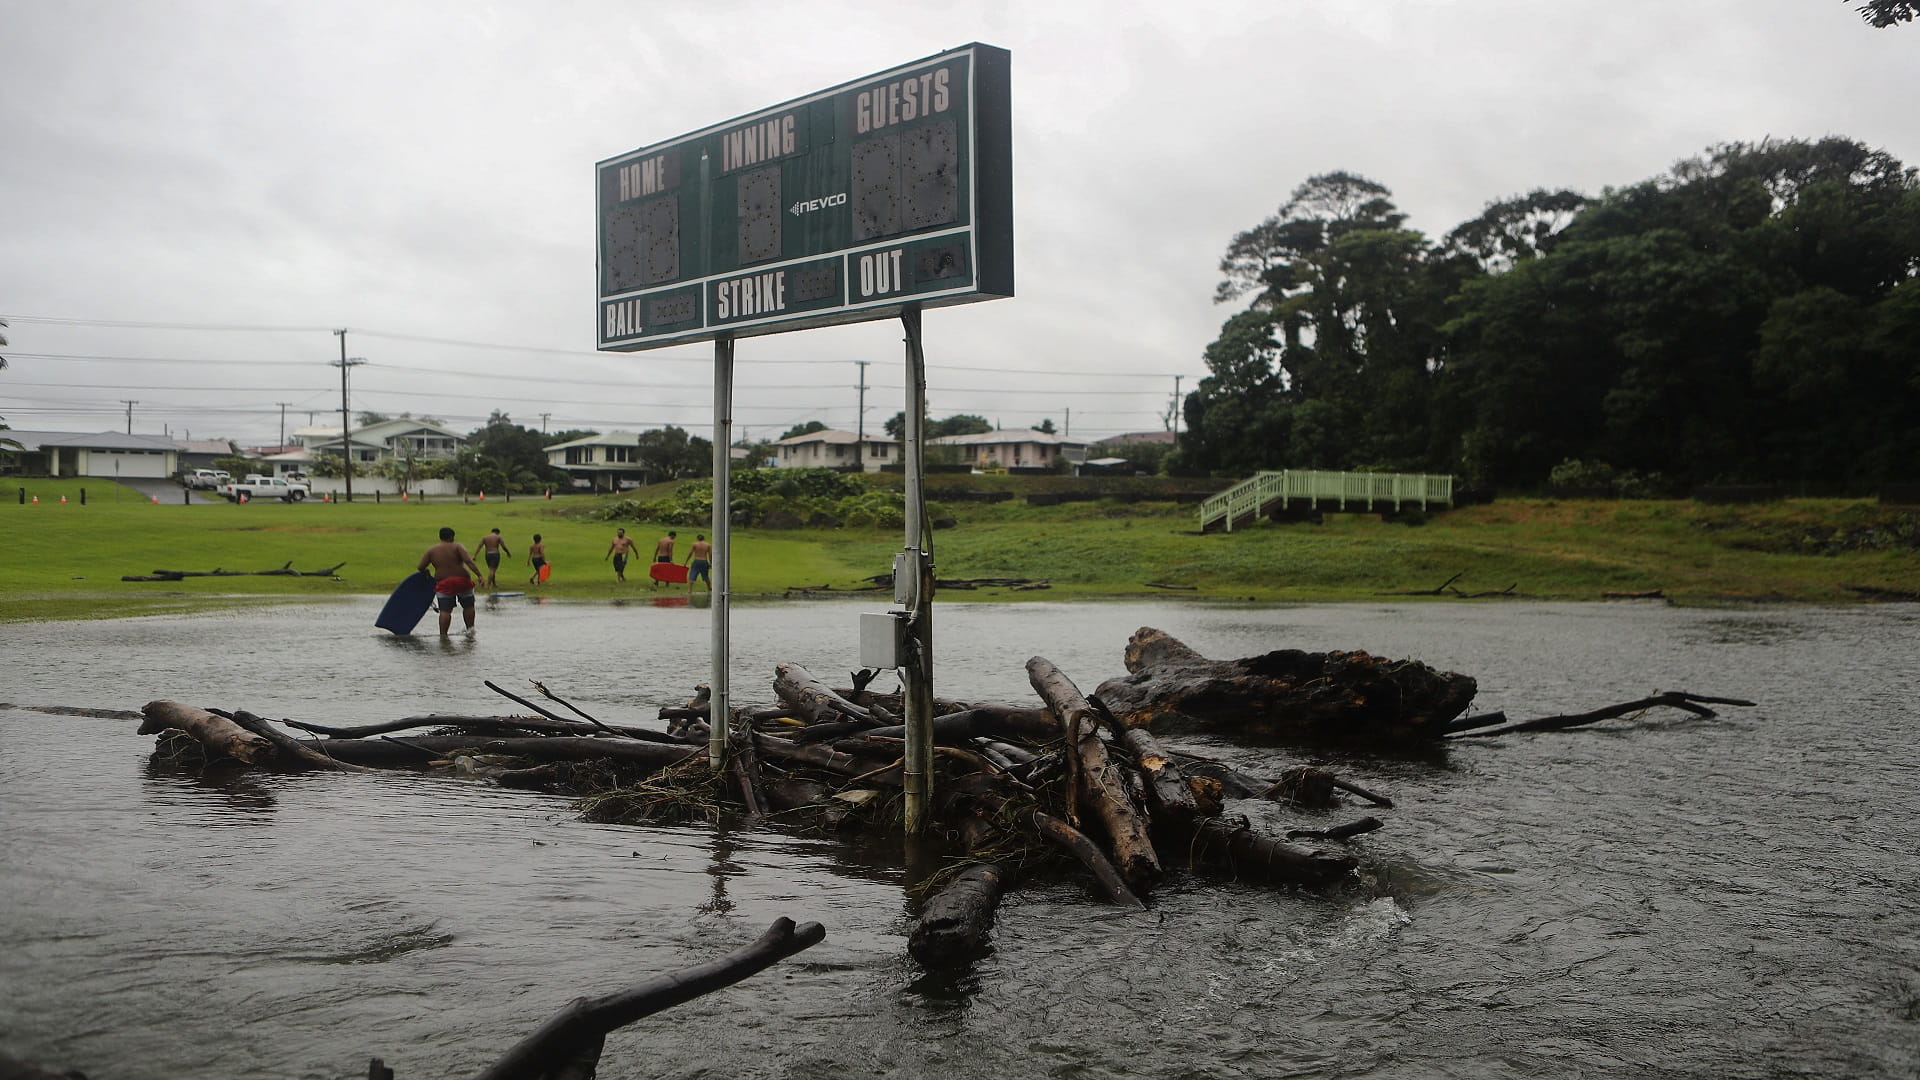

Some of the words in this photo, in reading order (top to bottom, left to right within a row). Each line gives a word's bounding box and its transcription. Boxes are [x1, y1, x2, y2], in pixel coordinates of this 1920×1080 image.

[857, 67, 950, 134] GUESTS
[722, 115, 795, 172] INNING
[619, 155, 665, 202] HOME
[799, 193, 847, 213] NEVCO
[718, 271, 785, 319] STRIKE
[860, 249, 903, 297] OUT
[606, 299, 642, 338] BALL
